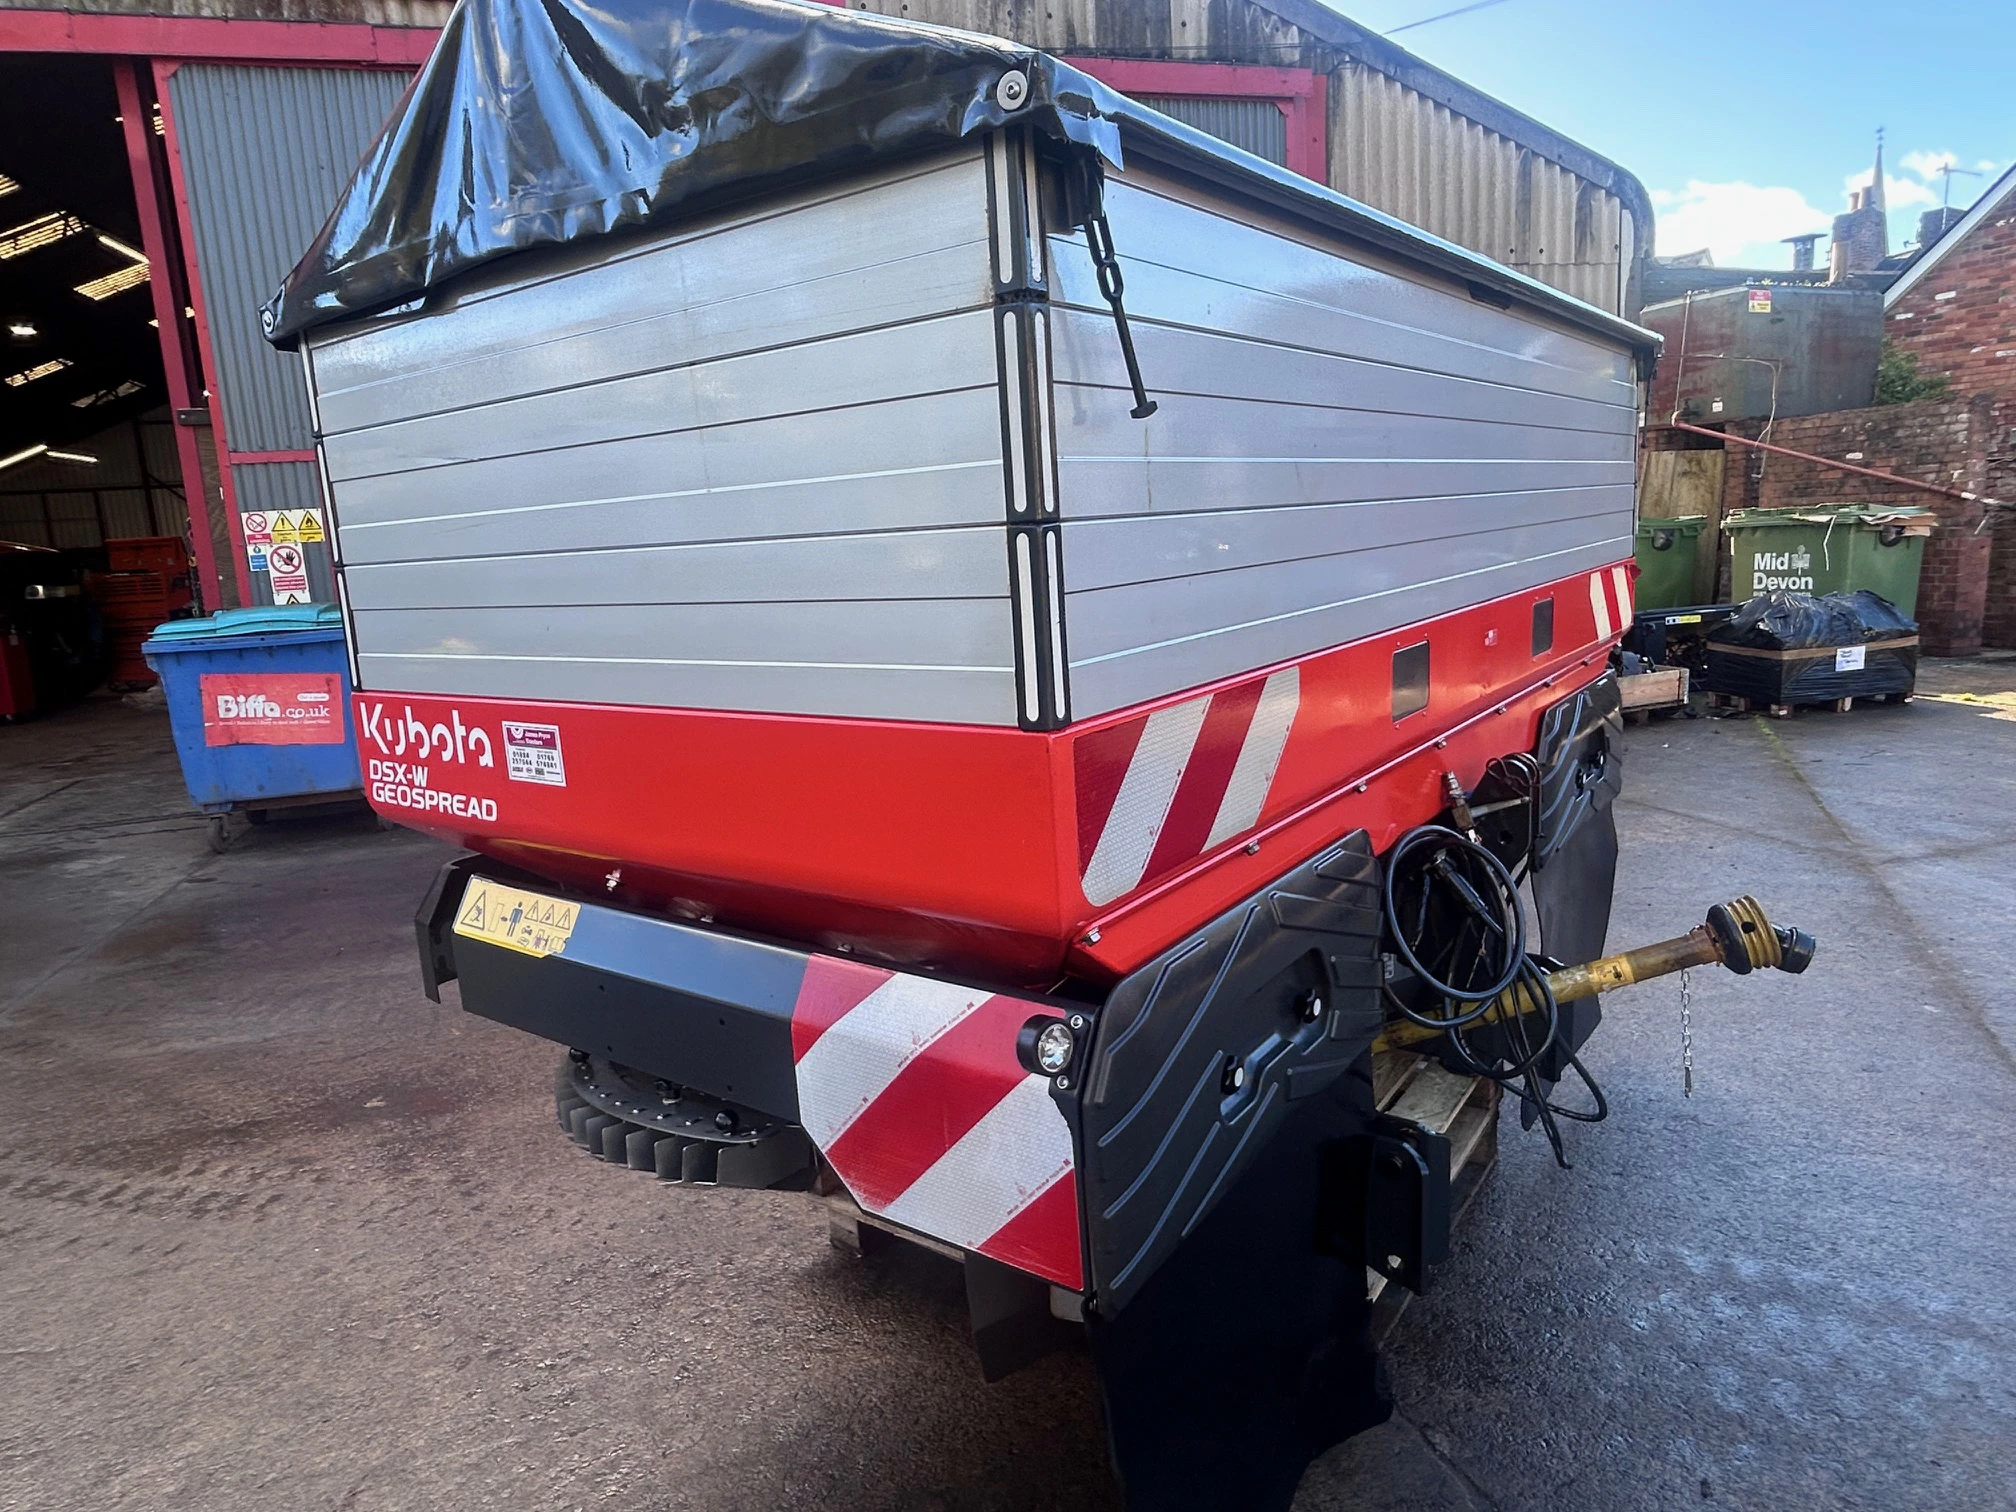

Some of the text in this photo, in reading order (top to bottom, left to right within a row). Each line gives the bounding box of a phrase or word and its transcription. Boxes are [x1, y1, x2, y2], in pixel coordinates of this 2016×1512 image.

[1754, 552, 1789, 570] Mid
[1753, 572, 1813, 590] Devon
[360, 702, 494, 767] Kubota
[369, 758, 428, 788] DSX-W
[372, 781, 498, 822] GEOSPREAD
